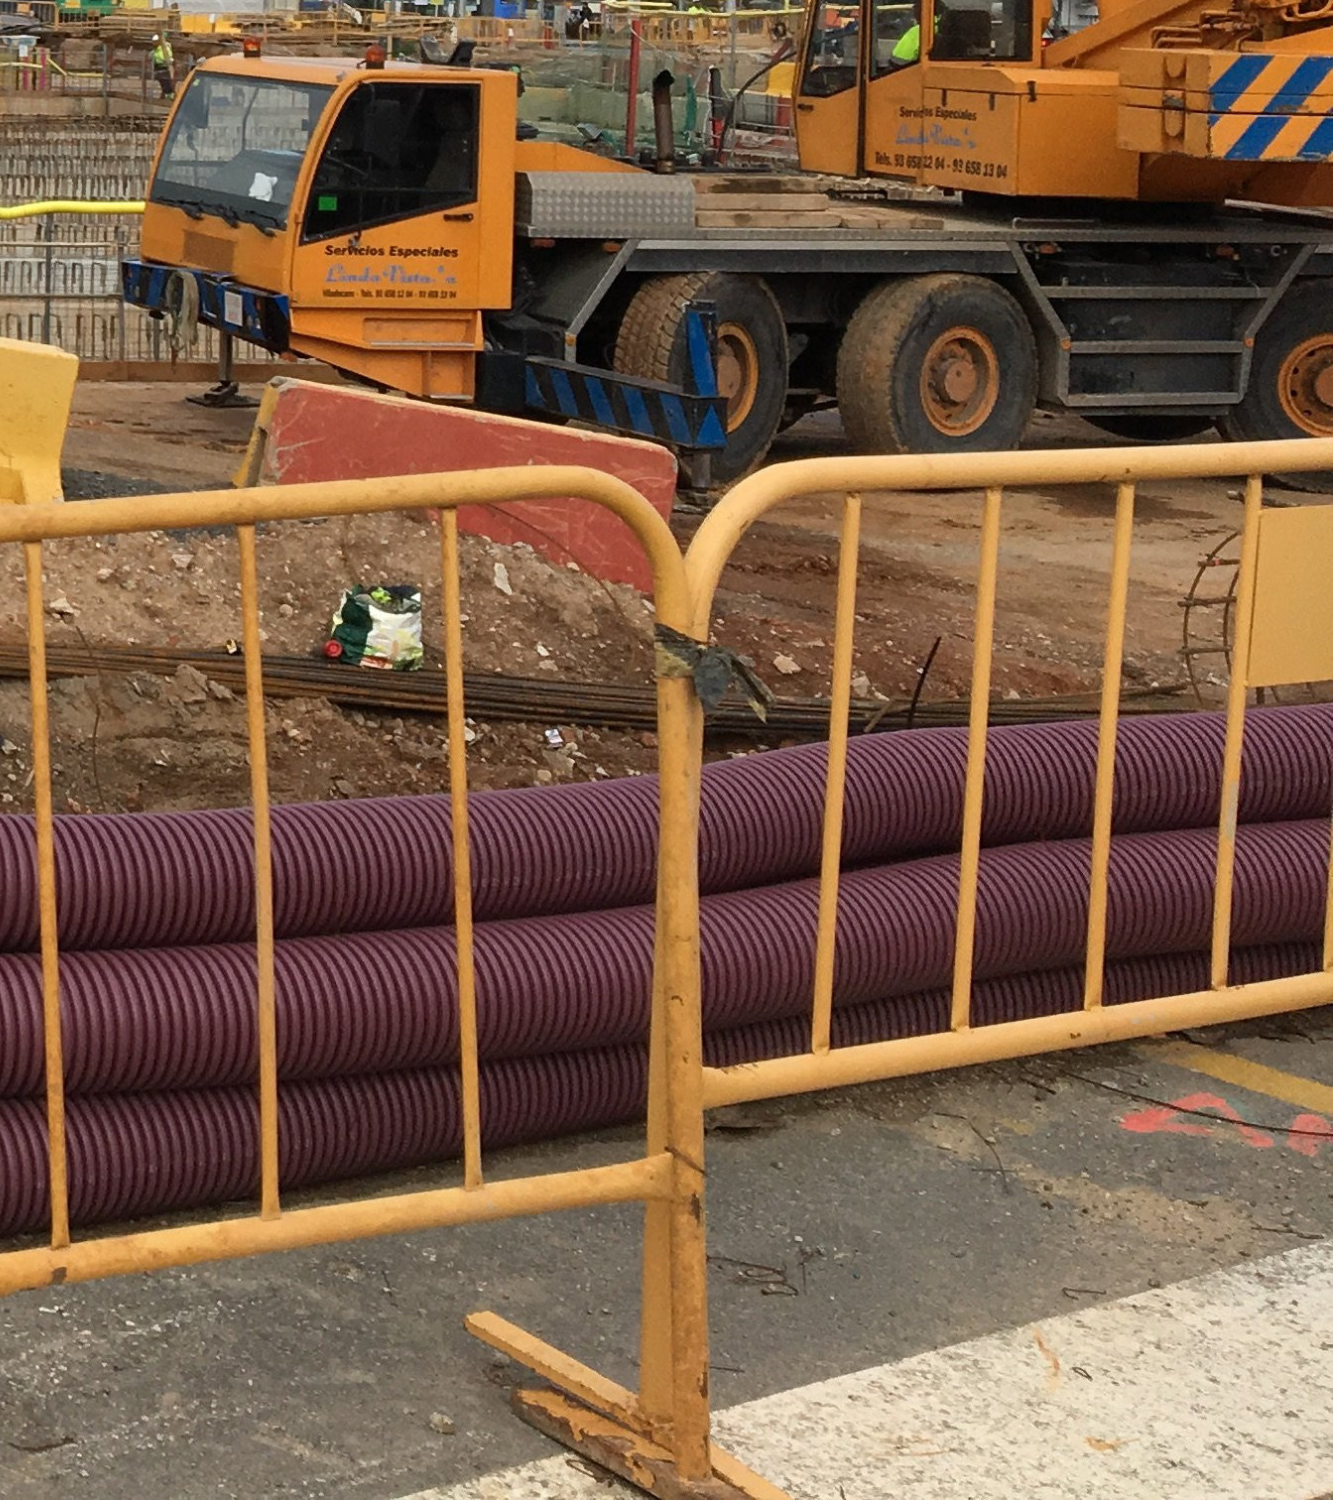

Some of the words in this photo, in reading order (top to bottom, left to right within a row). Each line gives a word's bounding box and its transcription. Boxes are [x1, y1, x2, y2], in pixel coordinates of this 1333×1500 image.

[935, 106, 977, 121] Especiales
[983, 162, 993, 178] 13
[996, 164, 1008, 179] 04
[325, 245, 385, 256] Servicios
[389, 245, 459, 258] Especiales
